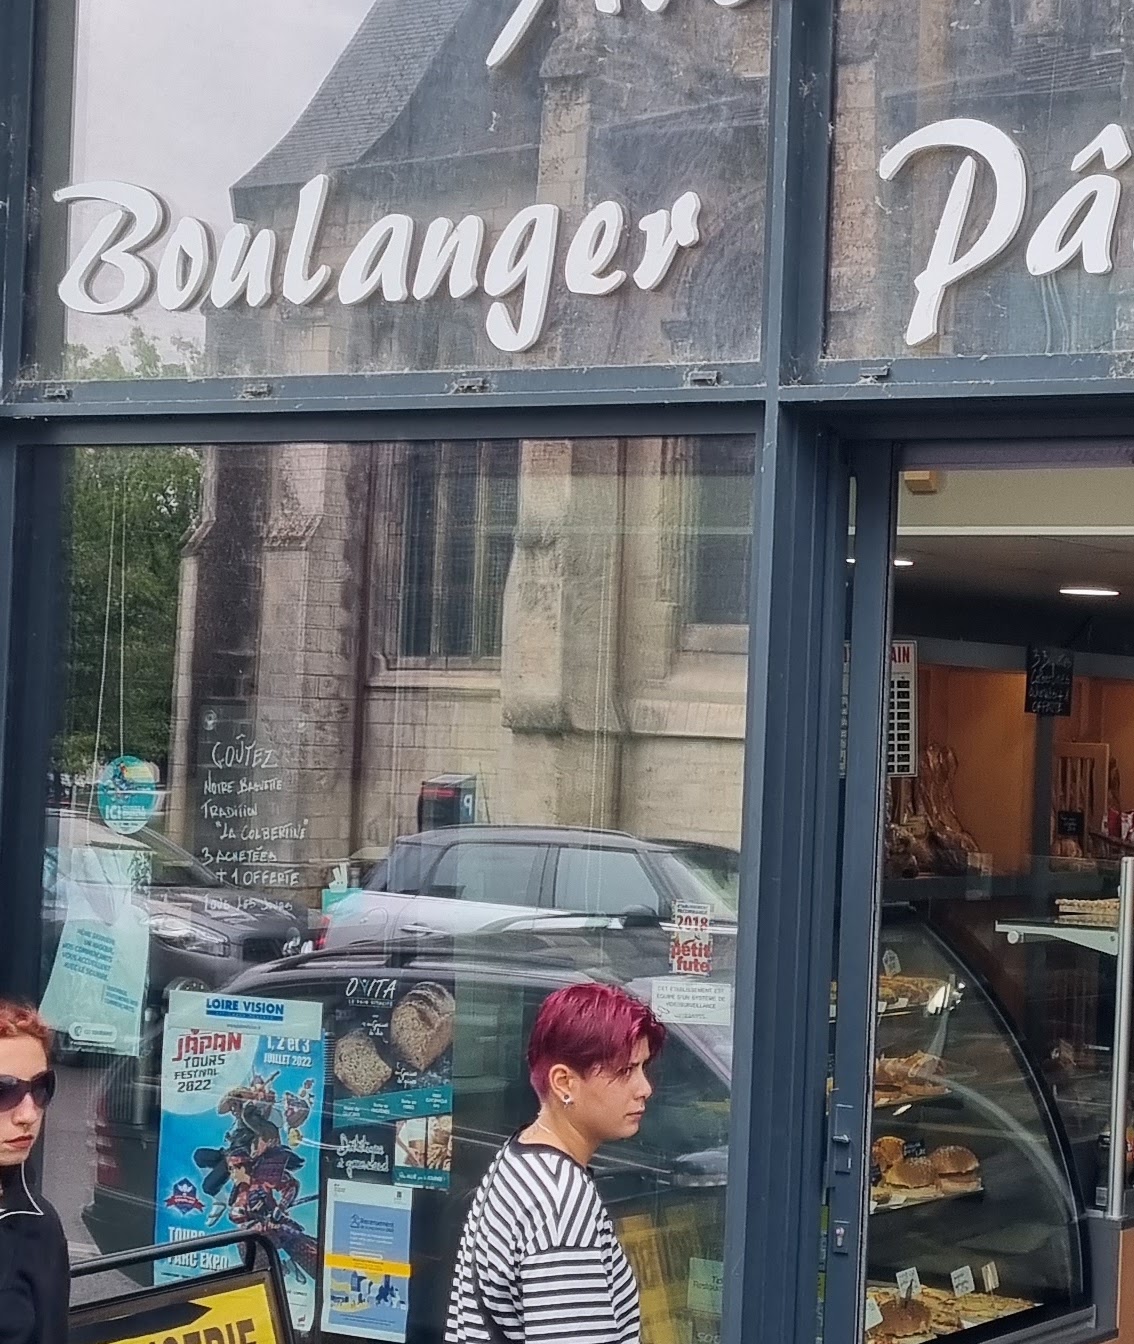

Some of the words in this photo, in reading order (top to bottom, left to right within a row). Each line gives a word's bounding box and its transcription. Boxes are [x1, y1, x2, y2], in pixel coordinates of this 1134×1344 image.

[54, 172, 702, 353] Boulanger
[212, 734, 278, 768] GOÛTEZ
[201, 847, 214, 865] 3
[243, 868, 300, 887] OFFERTE
[671, 941, 711, 958] petit
[206, 998, 239, 1011] LOIRE
[242, 1000, 285, 1015] VISION
[172, 1031, 242, 1062] JAPAN
[276, 1036, 285, 1051] 2
[288, 1037, 300, 1052] et
[302, 1038, 310, 1053] 3
[184, 1053, 226, 1068] TOURS
[264, 1052, 290, 1066] JUILLET
[291, 1055, 312, 1068] 2022
[177, 1079, 212, 1093] 2022
